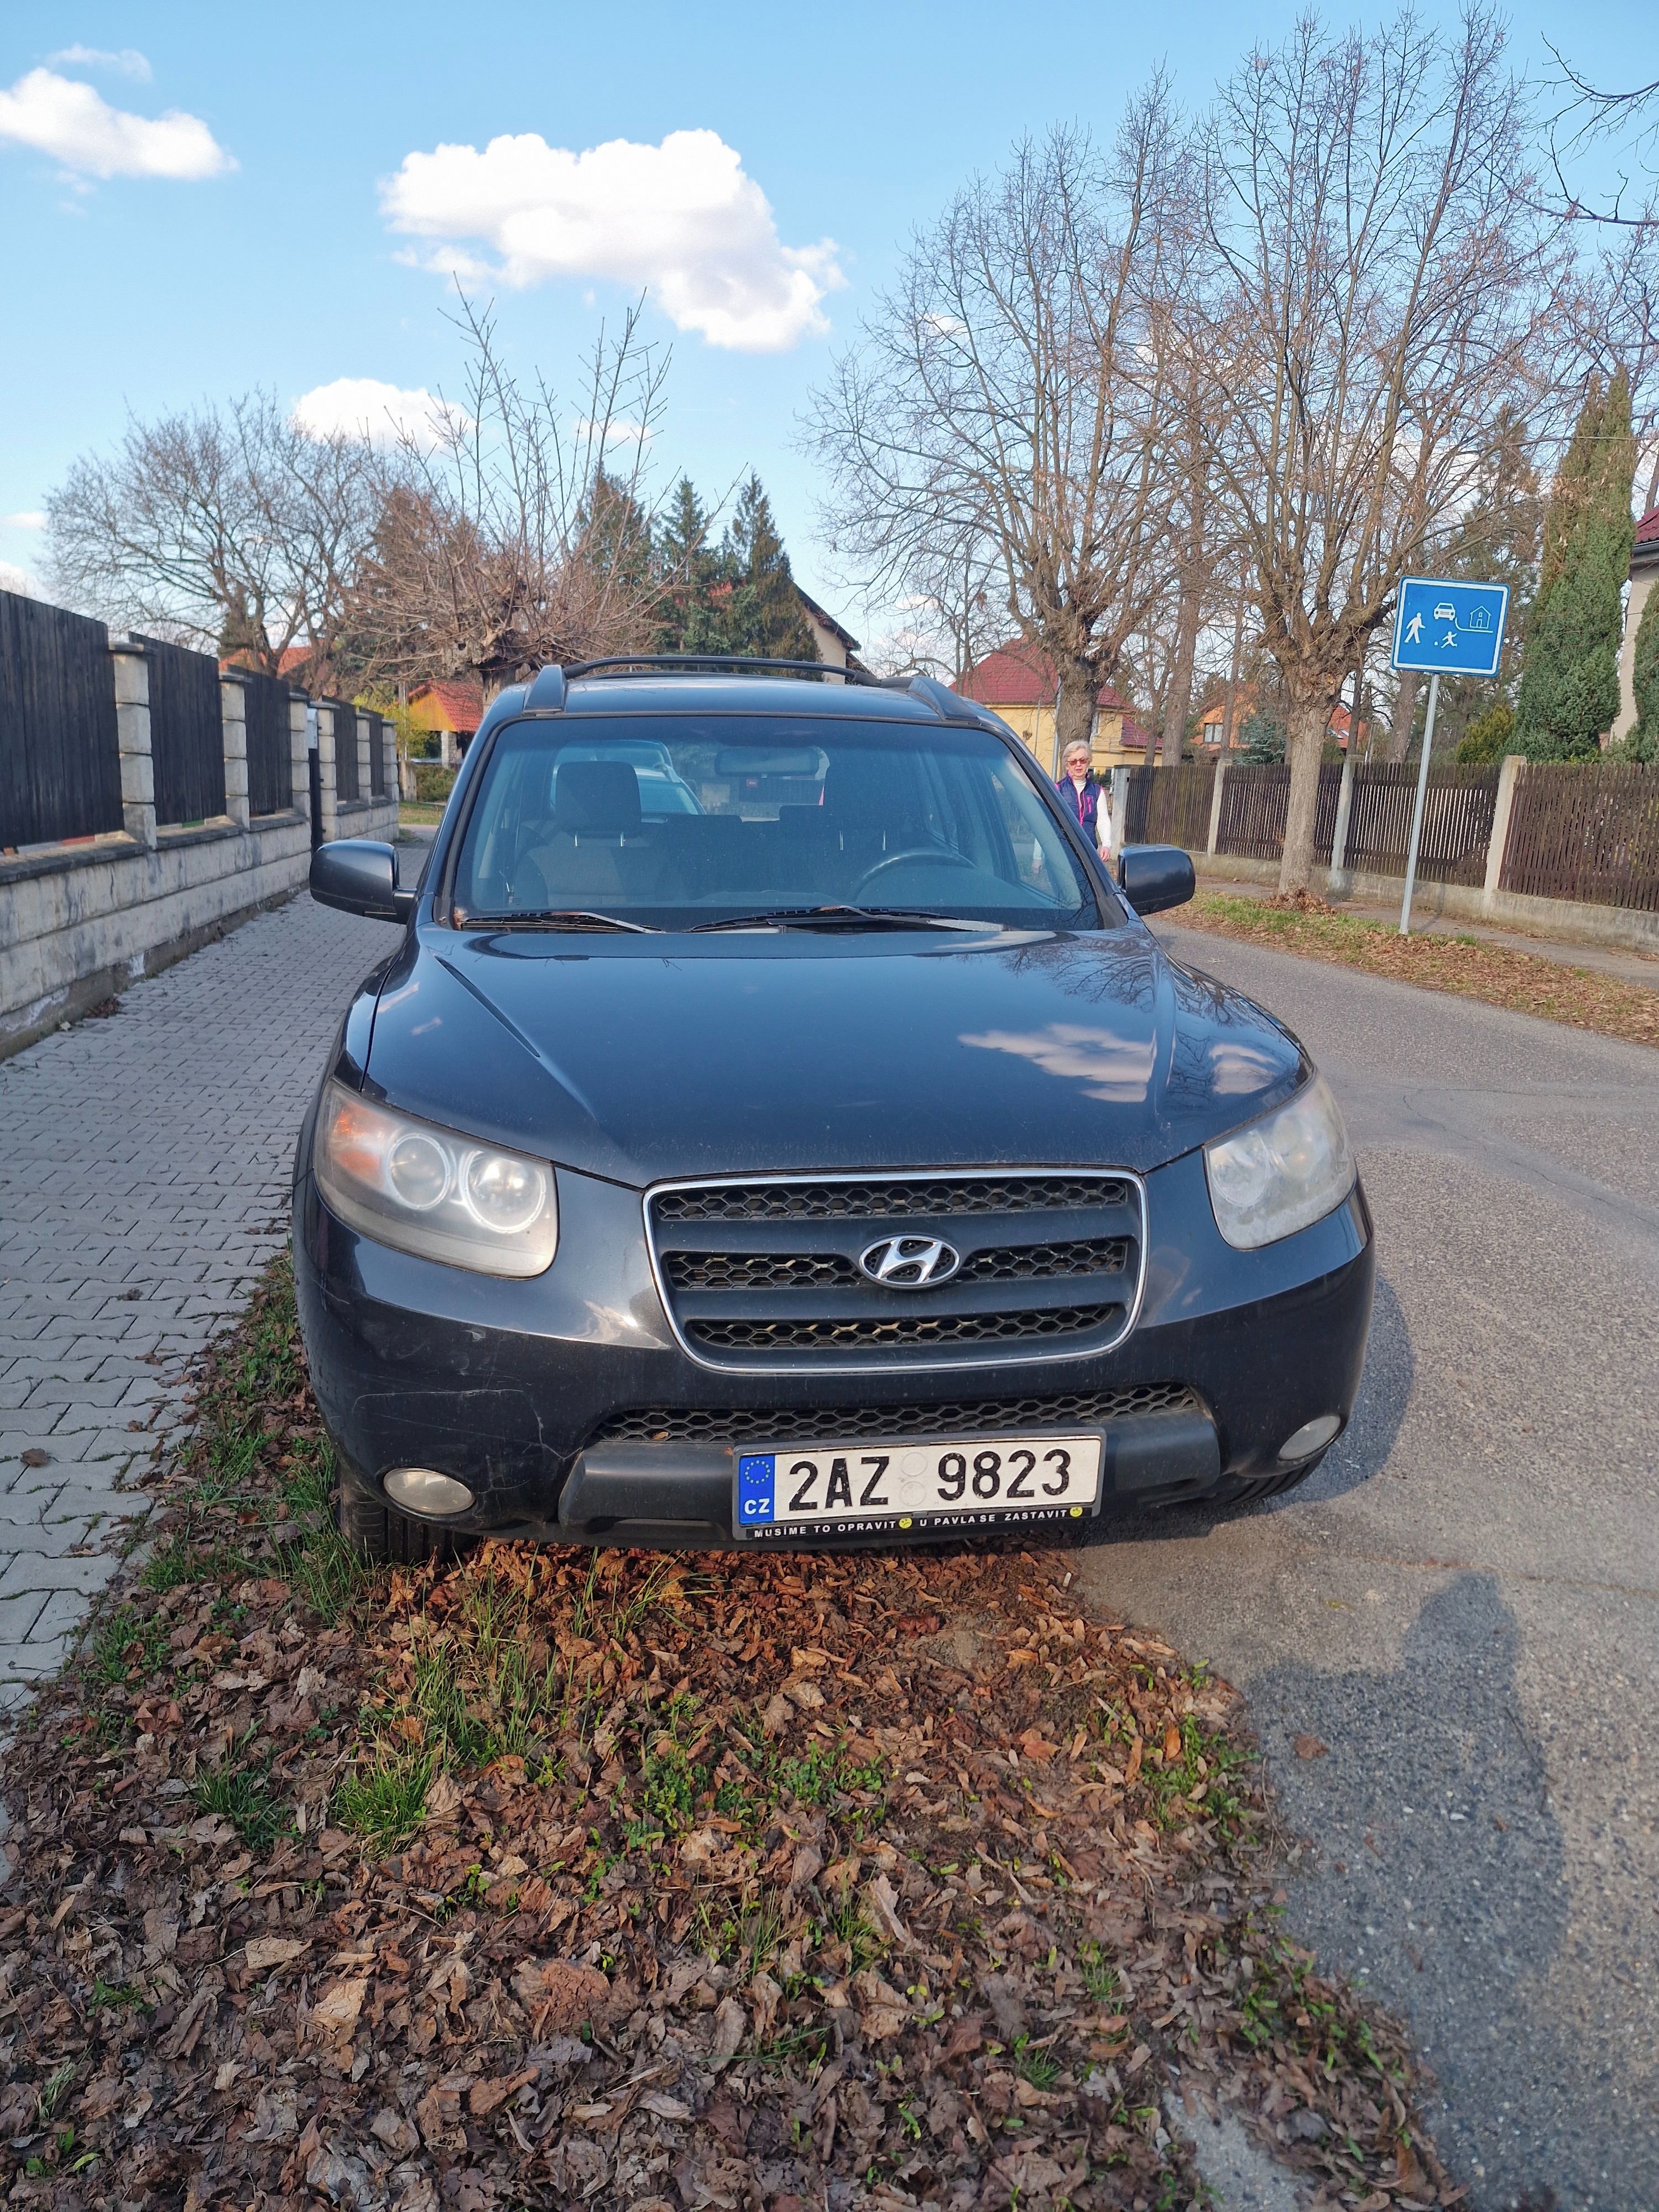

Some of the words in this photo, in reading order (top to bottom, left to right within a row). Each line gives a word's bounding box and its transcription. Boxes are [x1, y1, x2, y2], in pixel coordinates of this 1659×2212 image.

[789, 1455, 890, 1511] 2AZ
[937, 1448, 1071, 1501] 9823
[744, 1498, 770, 1515] CZ
[754, 1526, 807, 1538] MUSÍME
[813, 1525, 831, 1533] TO
[837, 1520, 896, 1532] OPRAVIT
[934, 1516, 975, 1526] PAVLA
[979, 1514, 995, 1523] SE
[1004, 1510, 1067, 1521] ZASTAVIT
